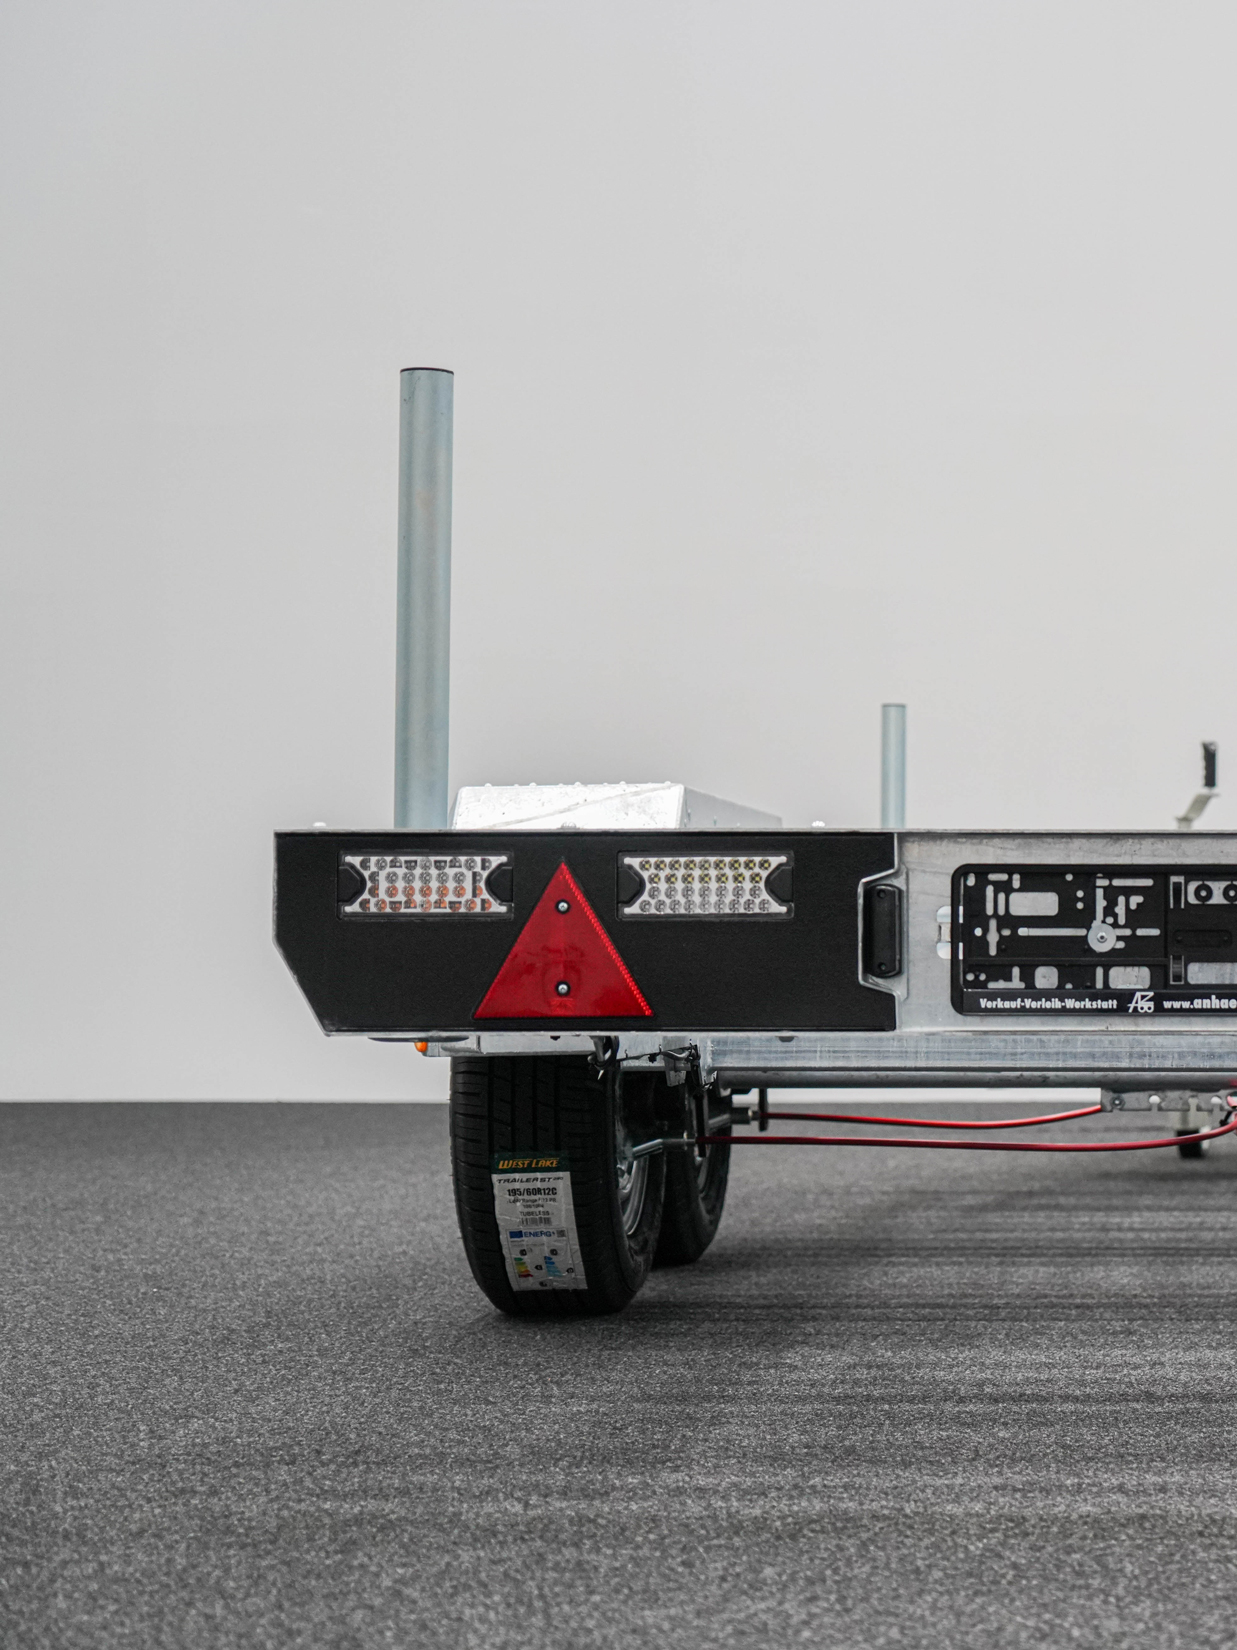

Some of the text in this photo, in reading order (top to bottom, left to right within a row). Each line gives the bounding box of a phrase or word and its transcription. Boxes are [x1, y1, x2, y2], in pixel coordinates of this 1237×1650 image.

[498, 1159, 559, 1169] WEST LAKE
[507, 1187, 557, 1197] 195/60R12C
